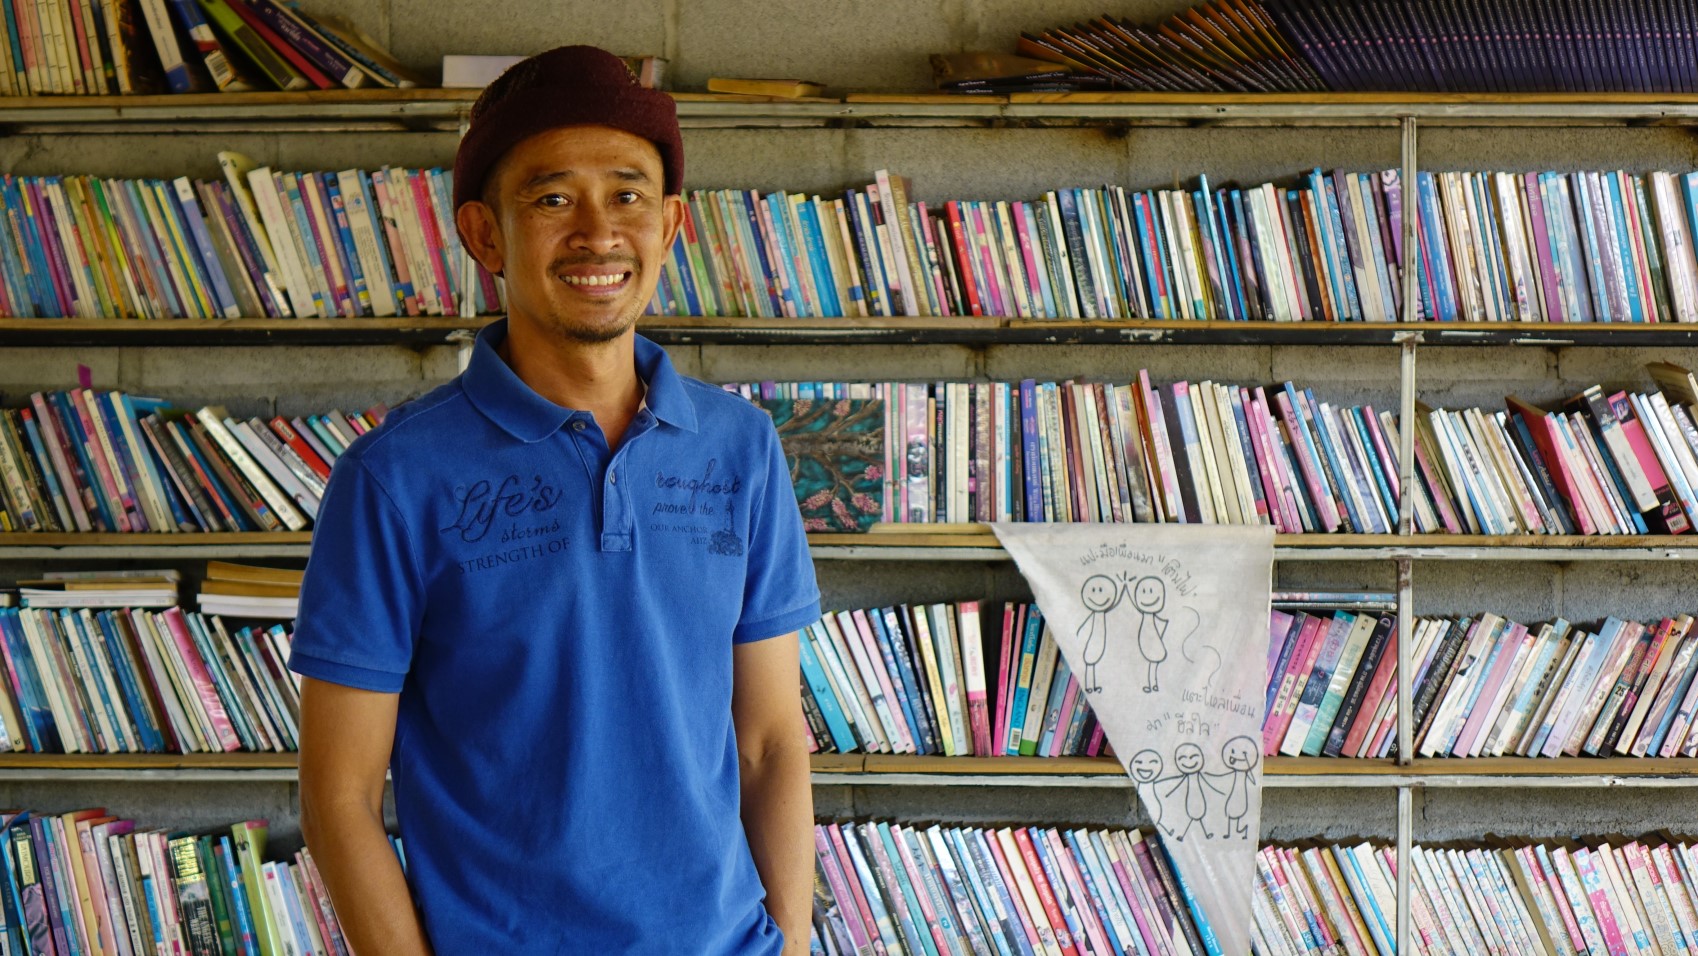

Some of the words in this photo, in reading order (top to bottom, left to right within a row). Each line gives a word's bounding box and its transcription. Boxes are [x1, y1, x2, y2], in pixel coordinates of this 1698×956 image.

[699, 501, 714, 516] the
[650, 523, 669, 532] OUR
[459, 544, 543, 575] STRENGTH
[548, 537, 571, 554] OF
